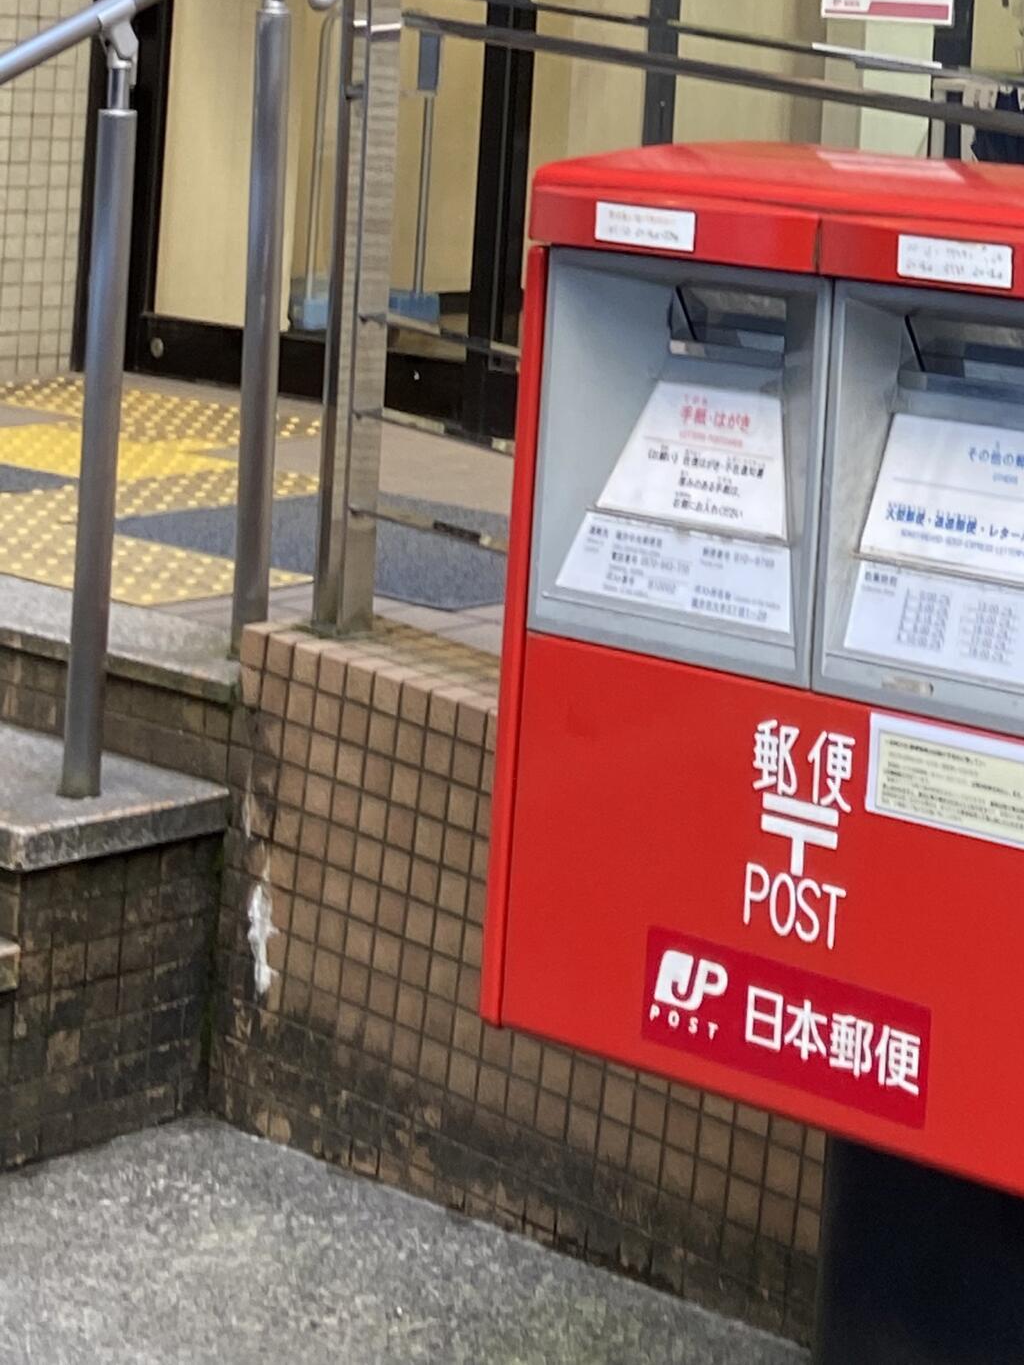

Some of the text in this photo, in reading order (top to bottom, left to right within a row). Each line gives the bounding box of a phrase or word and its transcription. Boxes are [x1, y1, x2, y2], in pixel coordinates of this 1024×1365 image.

[752, 719, 856, 814] 郵便
[742, 861, 847, 950] POST
[649, 1003, 719, 1040] POST
[744, 984, 922, 1097] 日本郵便
